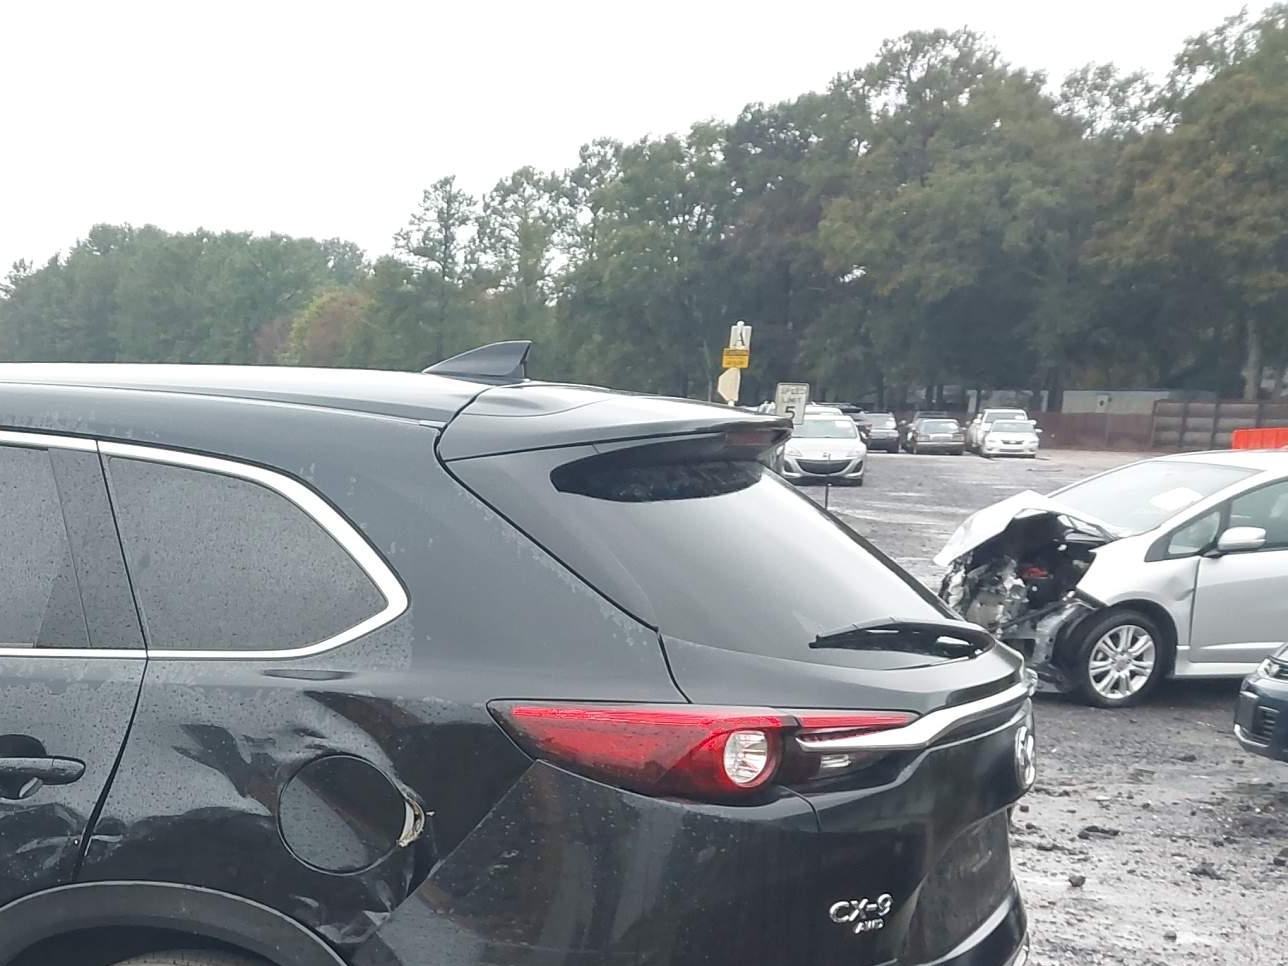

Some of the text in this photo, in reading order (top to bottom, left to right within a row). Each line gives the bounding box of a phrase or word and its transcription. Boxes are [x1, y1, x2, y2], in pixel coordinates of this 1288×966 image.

[733, 328, 746, 347] A
[785, 405, 796, 420] 5
[829, 893, 892, 923] CX-9
